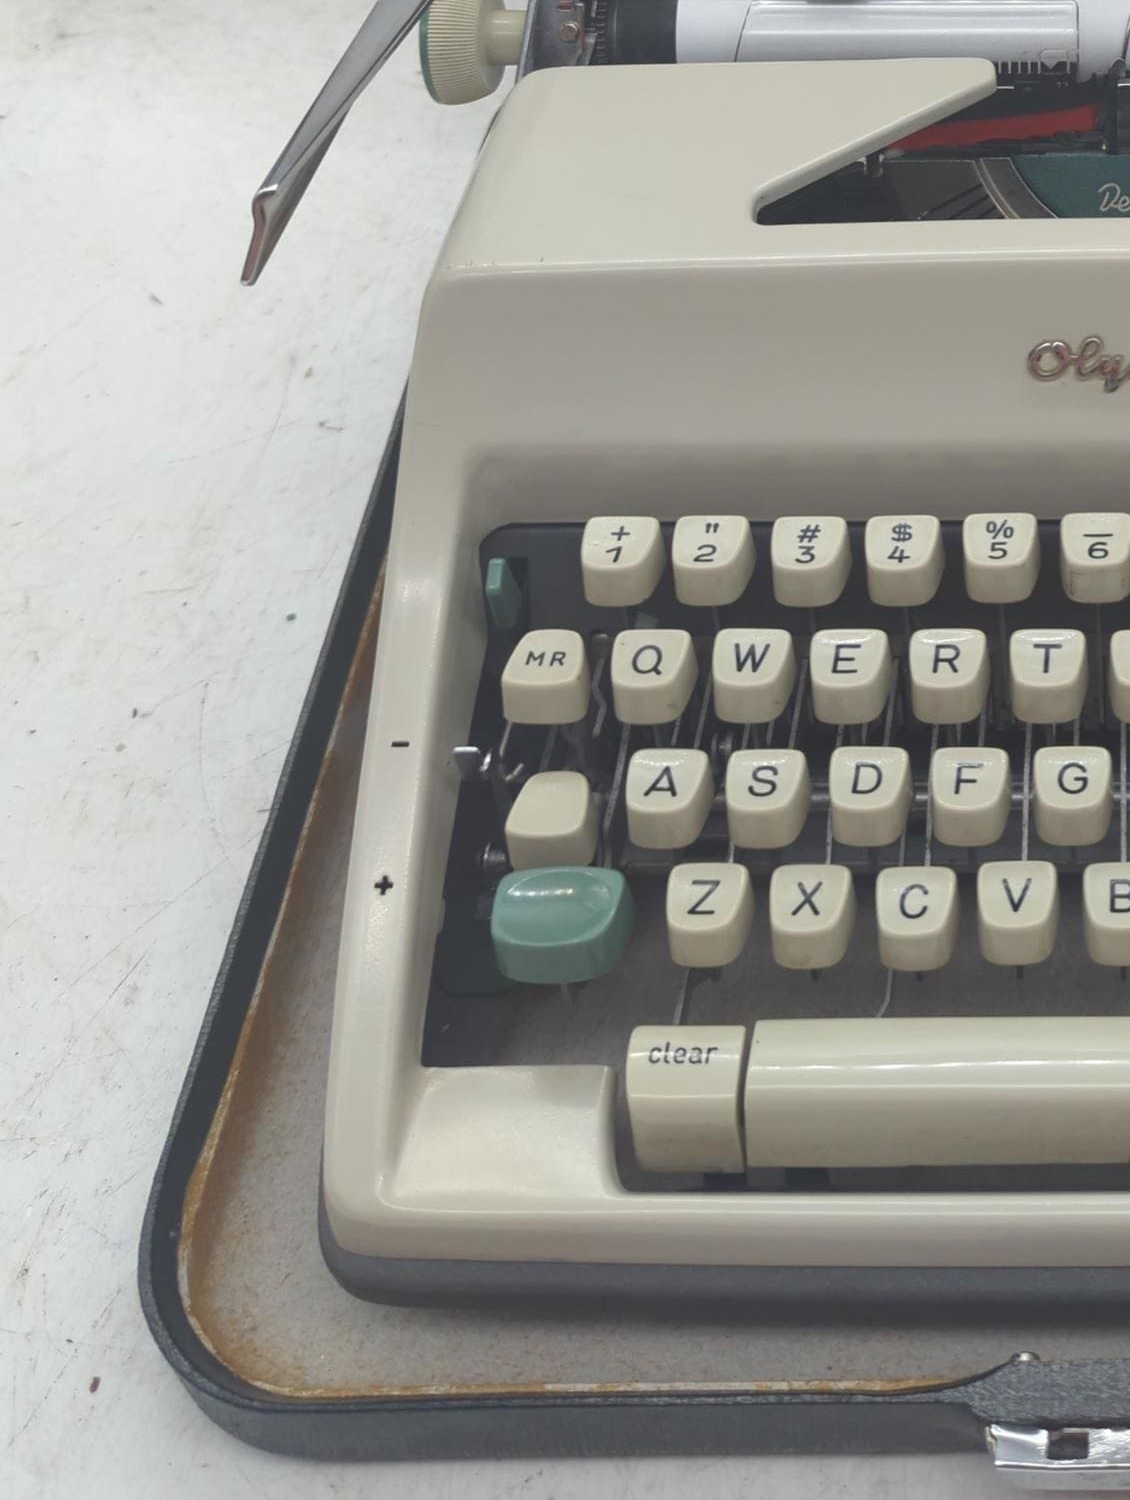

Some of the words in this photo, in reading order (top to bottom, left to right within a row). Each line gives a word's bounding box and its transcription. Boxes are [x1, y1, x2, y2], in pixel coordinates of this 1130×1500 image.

[798, 525, 821, 542] #
[892, 522, 912, 542] $
[986, 520, 1013, 539] %
[606, 546, 622, 562] 1
[694, 545, 717, 562] 2
[795, 546, 816, 563] 3
[888, 546, 910, 563] 4
[988, 542, 1008, 559] 5
[1088, 542, 1109, 559] 6
[632, 646, 662, 675] Q
[734, 643, 770, 672] W
[832, 645, 863, 673] E
[932, 644, 961, 673] R
[1033, 644, 1062, 673] T
[643, 766, 677, 797] A
[748, 766, 778, 796] S
[851, 762, 883, 794] D
[954, 762, 984, 794] F
[1058, 762, 1089, 794] G
[688, 880, 720, 915] Z
[791, 882, 822, 916] X
[900, 884, 929, 919] C
[1002, 878, 1032, 912] V
[648, 1041, 719, 1065] clear
